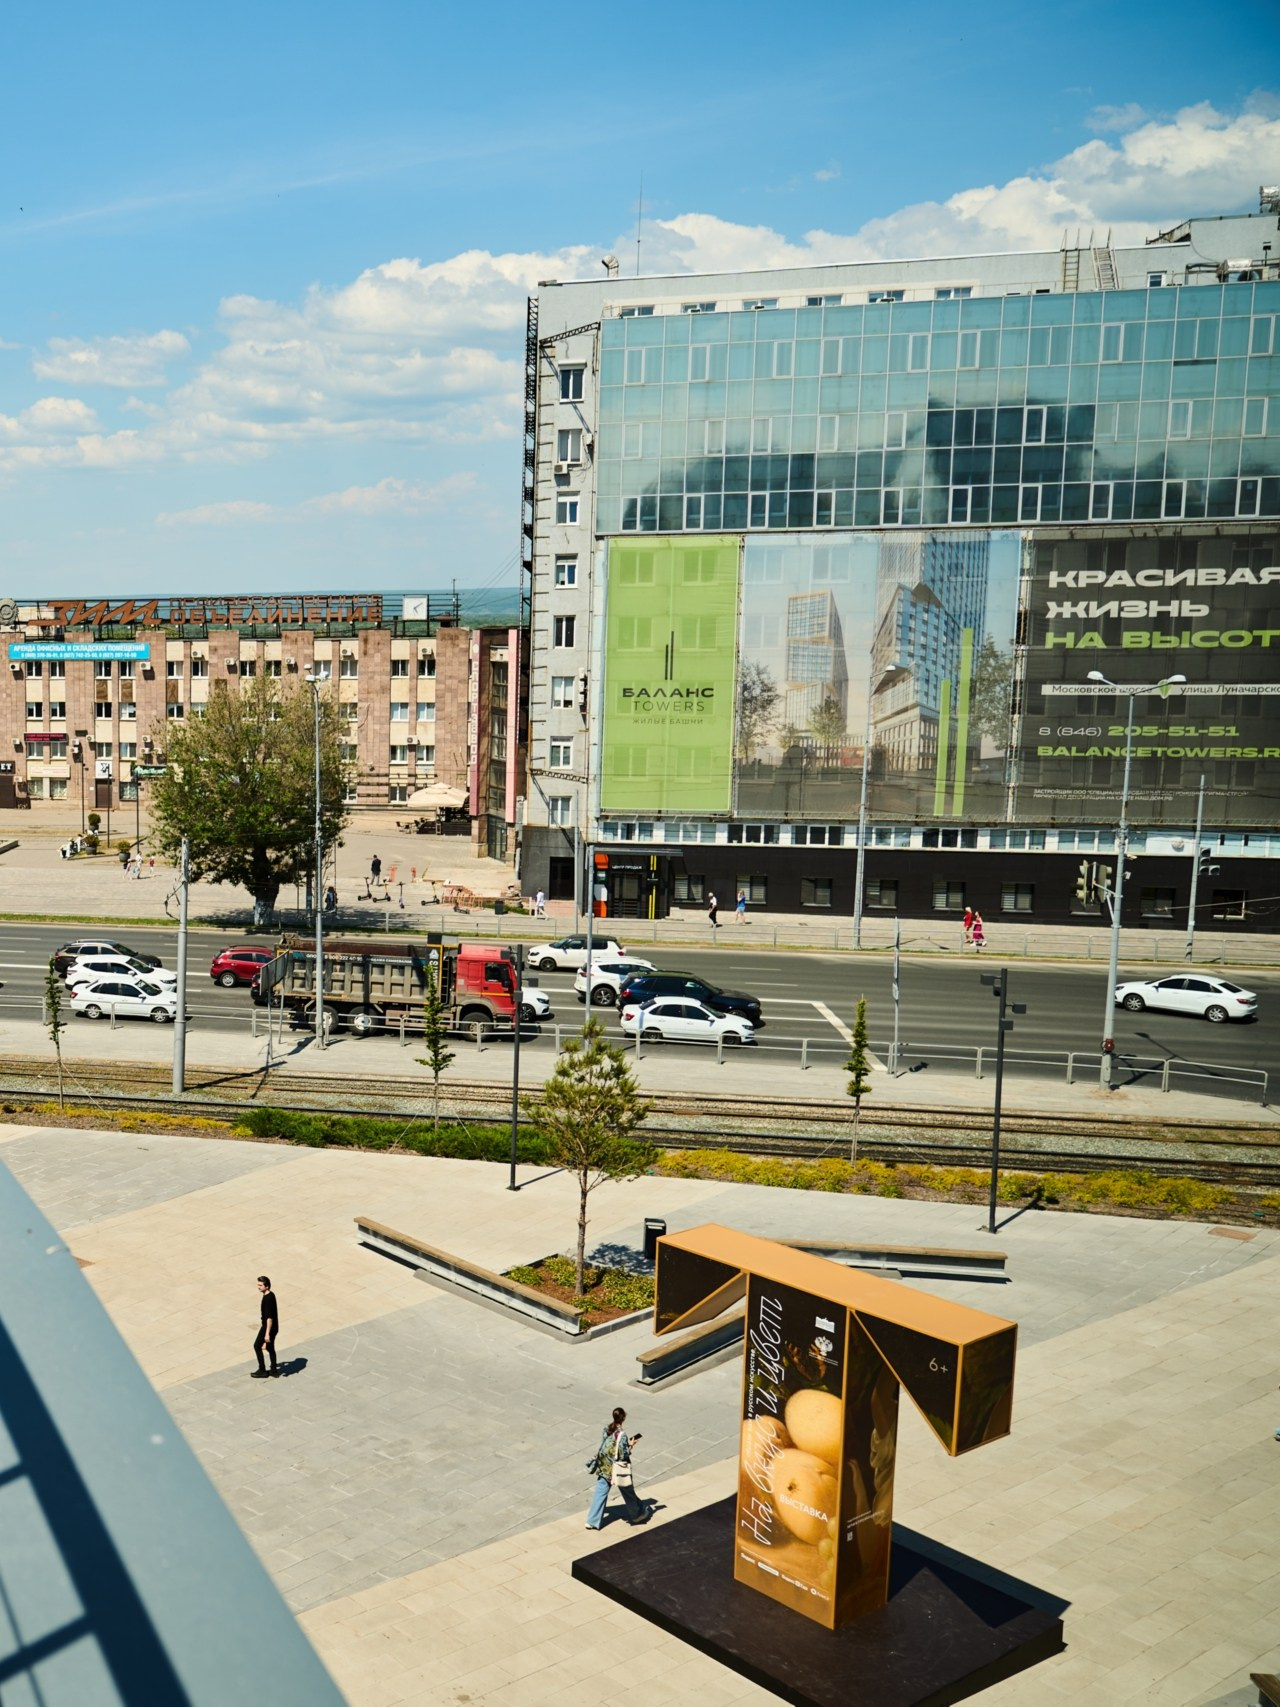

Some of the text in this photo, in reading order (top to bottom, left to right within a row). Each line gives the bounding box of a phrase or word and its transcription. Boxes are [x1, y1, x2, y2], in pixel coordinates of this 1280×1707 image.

[27, 600, 163, 625] ЗИМ
[170, 607, 382, 624] ОБЪЕДИНЕНИЕ
[1045, 600, 1210, 618] ЖИЗНЬ
[1045, 632, 1107, 648] НА
[622, 688, 714, 698] БАЛАНС
[633, 701, 705, 711] TOWERS
[1038, 725, 1240, 737] 8 (846) 205-51-51
[929, 1357, 948, 1373] 6+
[747, 1384, 755, 1413] русском
[744, 1414, 785, 1494] вкус
[779, 1493, 829, 1522] ВЫСТАВКА
[741, 1497, 773, 1546] На
